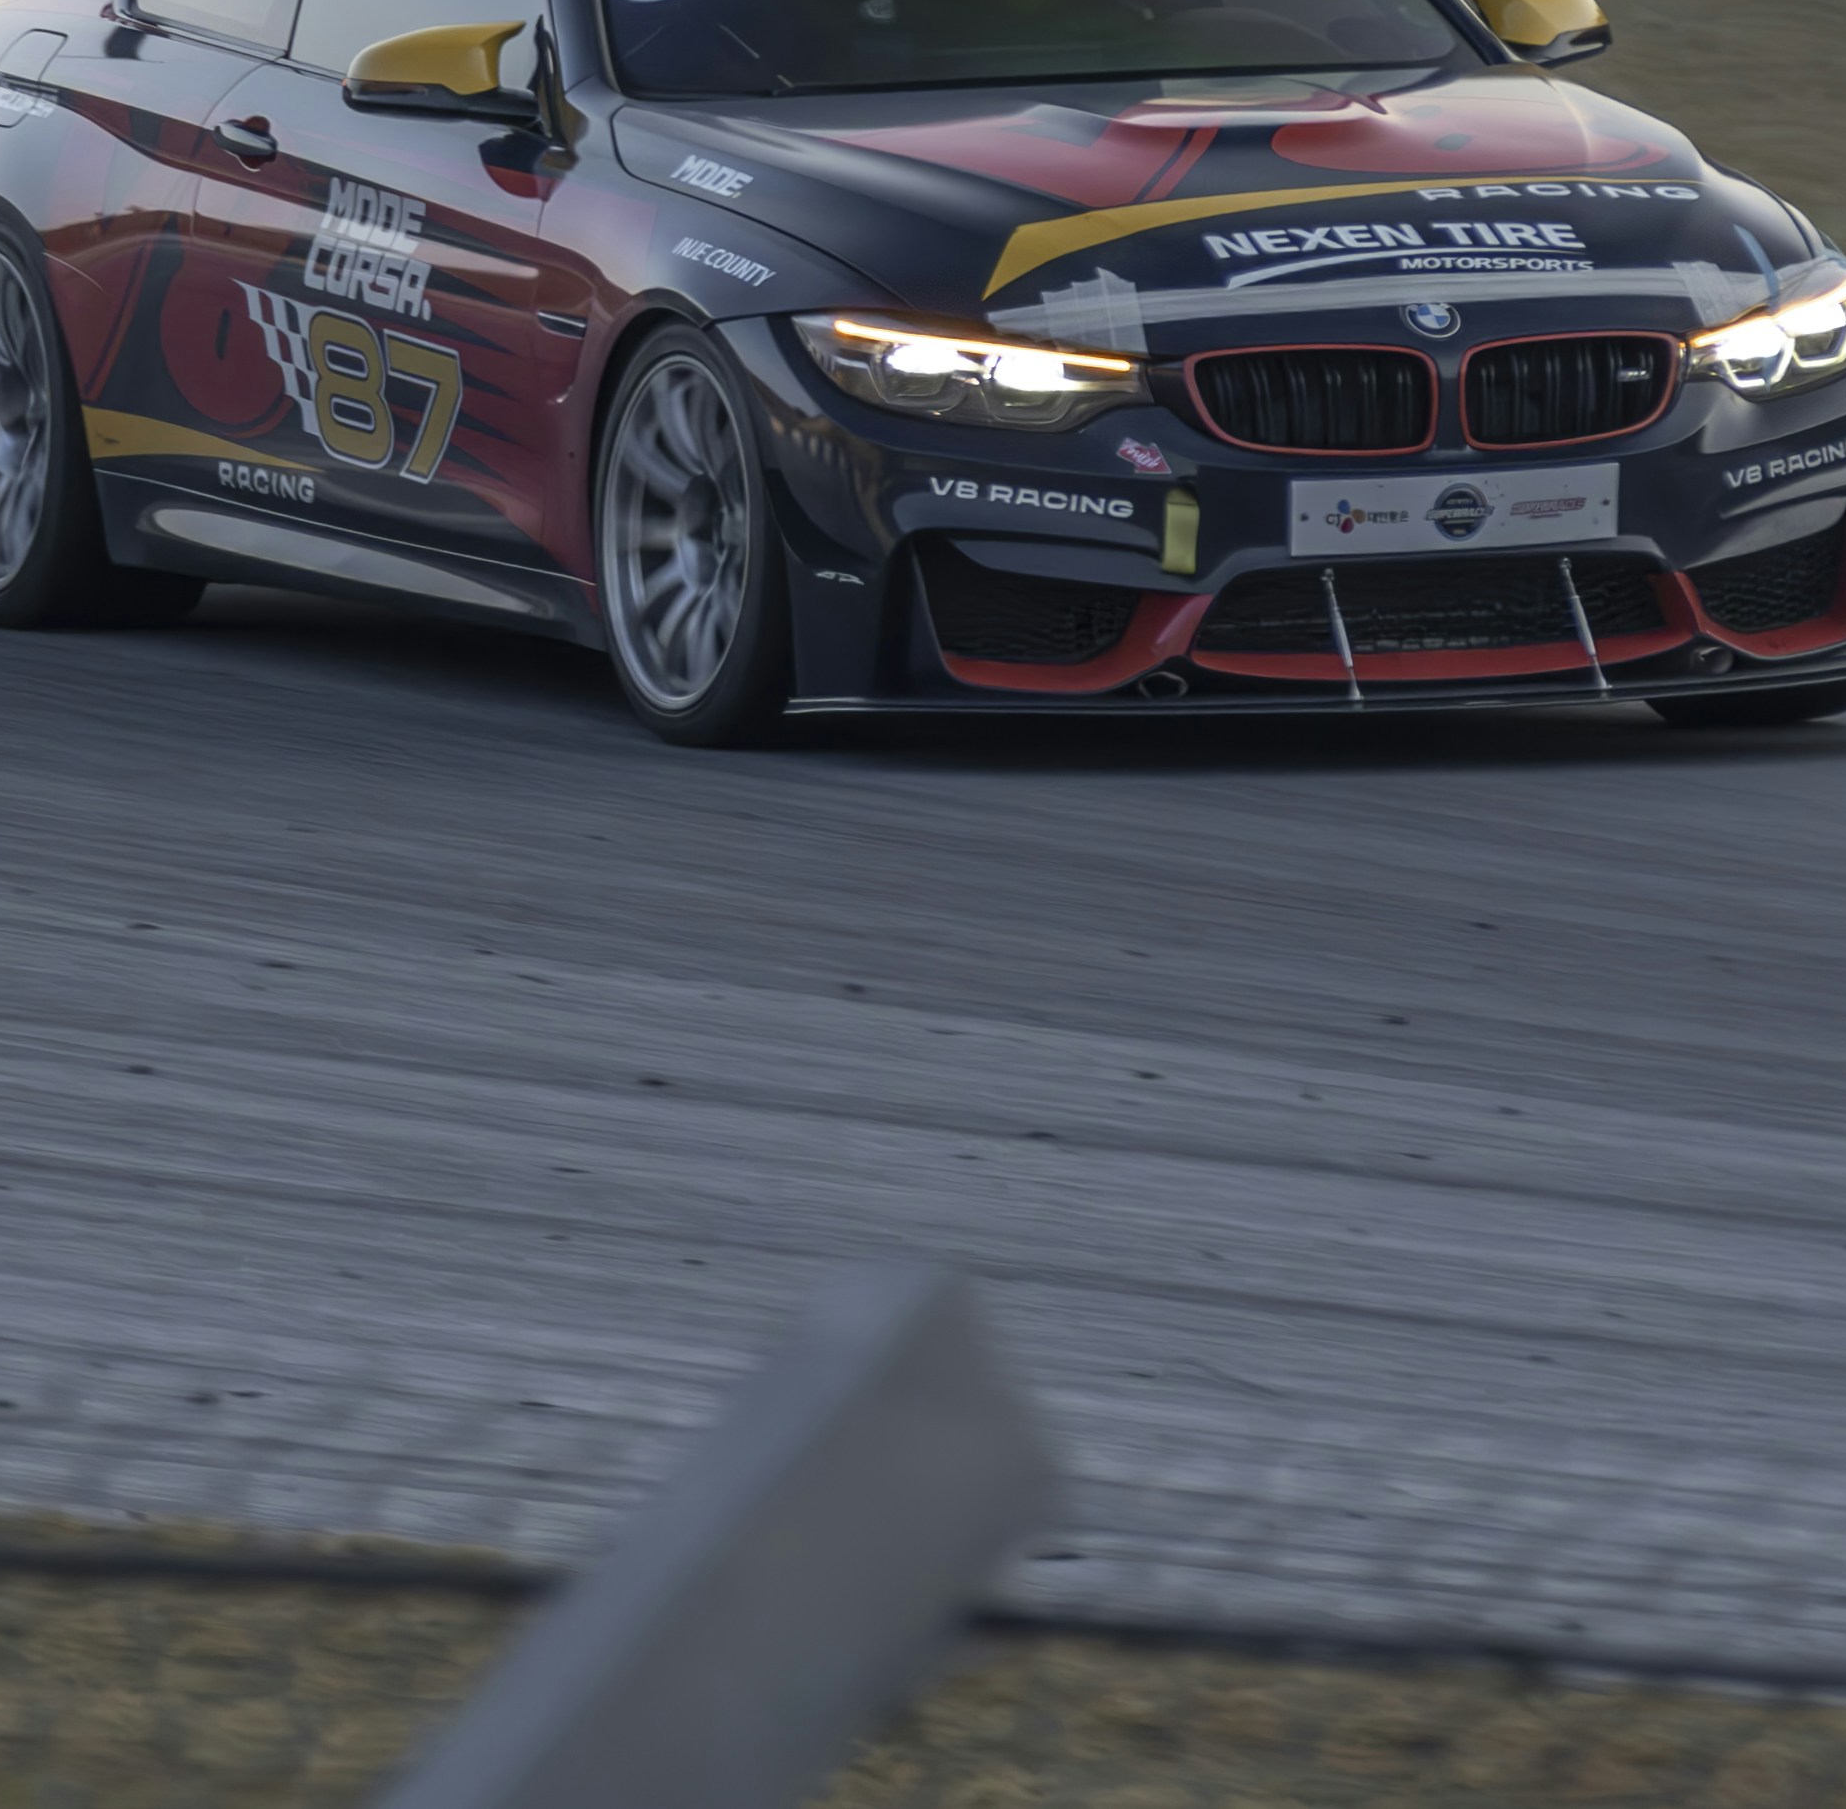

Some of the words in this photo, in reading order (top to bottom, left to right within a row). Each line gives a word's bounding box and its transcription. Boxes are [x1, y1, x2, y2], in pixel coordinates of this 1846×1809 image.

[1417, 183, 1700, 202] RACING
[320, 177, 426, 254] MODE
[1203, 222, 1425, 259] NEXEN
[1432, 222, 1587, 249] TIRE
[672, 237, 714, 261] INJE
[704, 248, 777, 287] COUNTY
[1400, 256, 1594, 272] MOTORSPORTS
[308, 306, 464, 485] 87
[218, 461, 315, 504] RACING
[930, 476, 979, 500] V8
[988, 484, 1134, 518] RACING
[1724, 464, 1763, 489] V8
